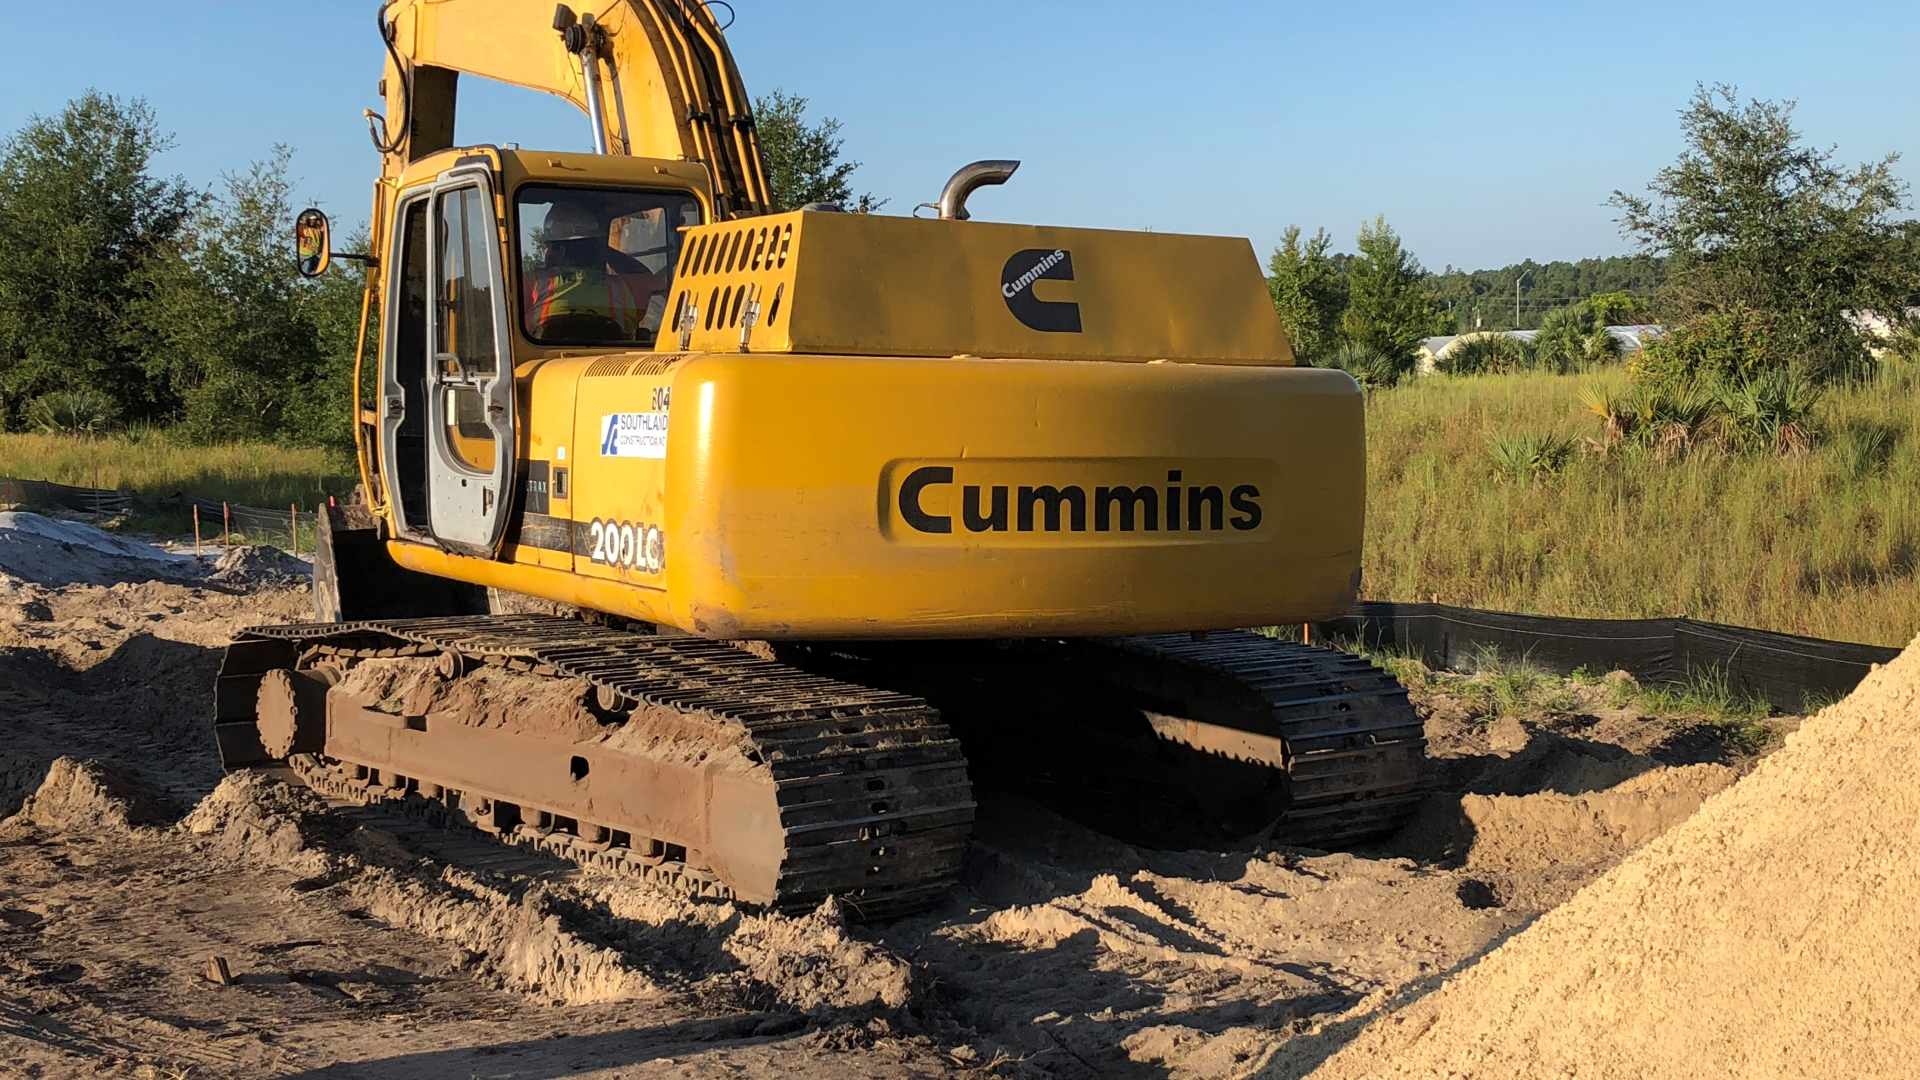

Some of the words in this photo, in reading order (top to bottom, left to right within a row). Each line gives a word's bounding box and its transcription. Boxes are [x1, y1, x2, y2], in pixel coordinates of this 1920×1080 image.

[1002, 249, 1065, 298] Cummins
[620, 414, 669, 431] SOUTHLAND
[899, 466, 1262, 534] Cummins
